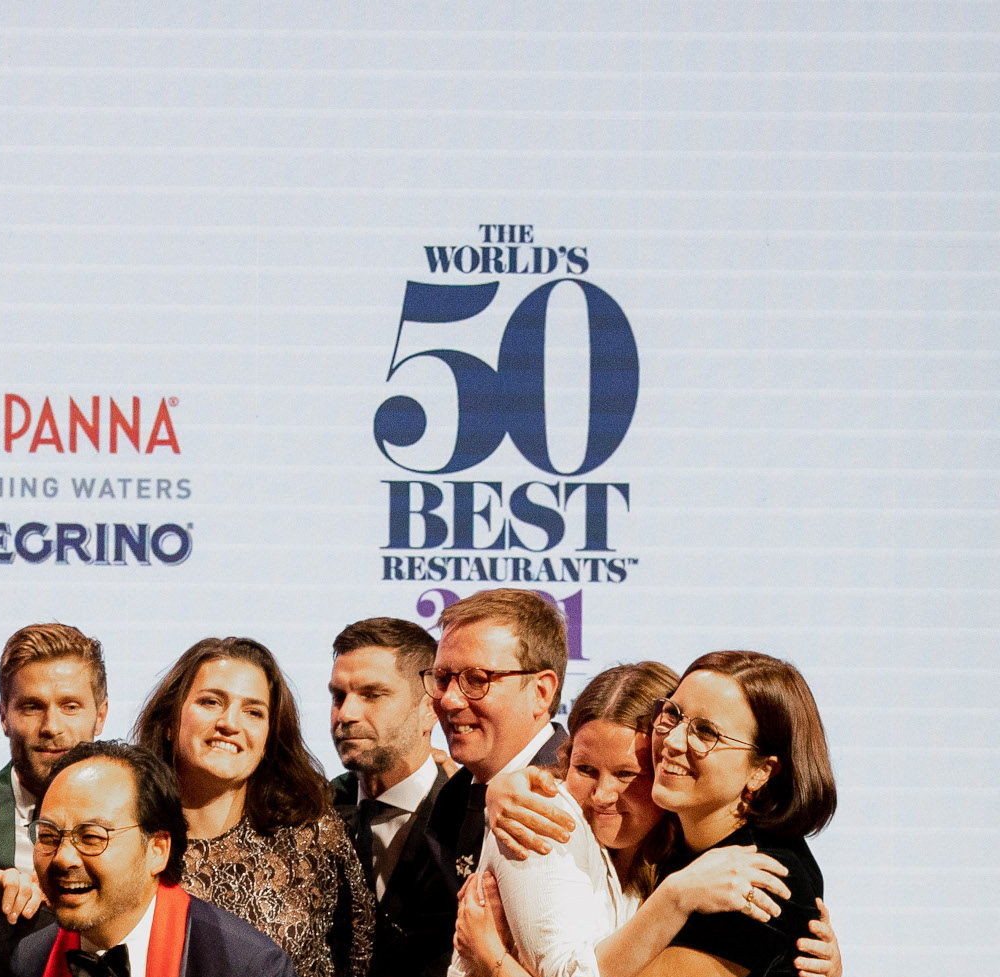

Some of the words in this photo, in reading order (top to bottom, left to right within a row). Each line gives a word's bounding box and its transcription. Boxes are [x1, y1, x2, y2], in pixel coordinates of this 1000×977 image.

[479, 223, 534, 244] THE
[424, 246, 590, 275] WORLD'S
[373, 278, 640, 477] 50
[72, 478, 192, 500] WATERS
[380, 480, 630, 553] BEST
